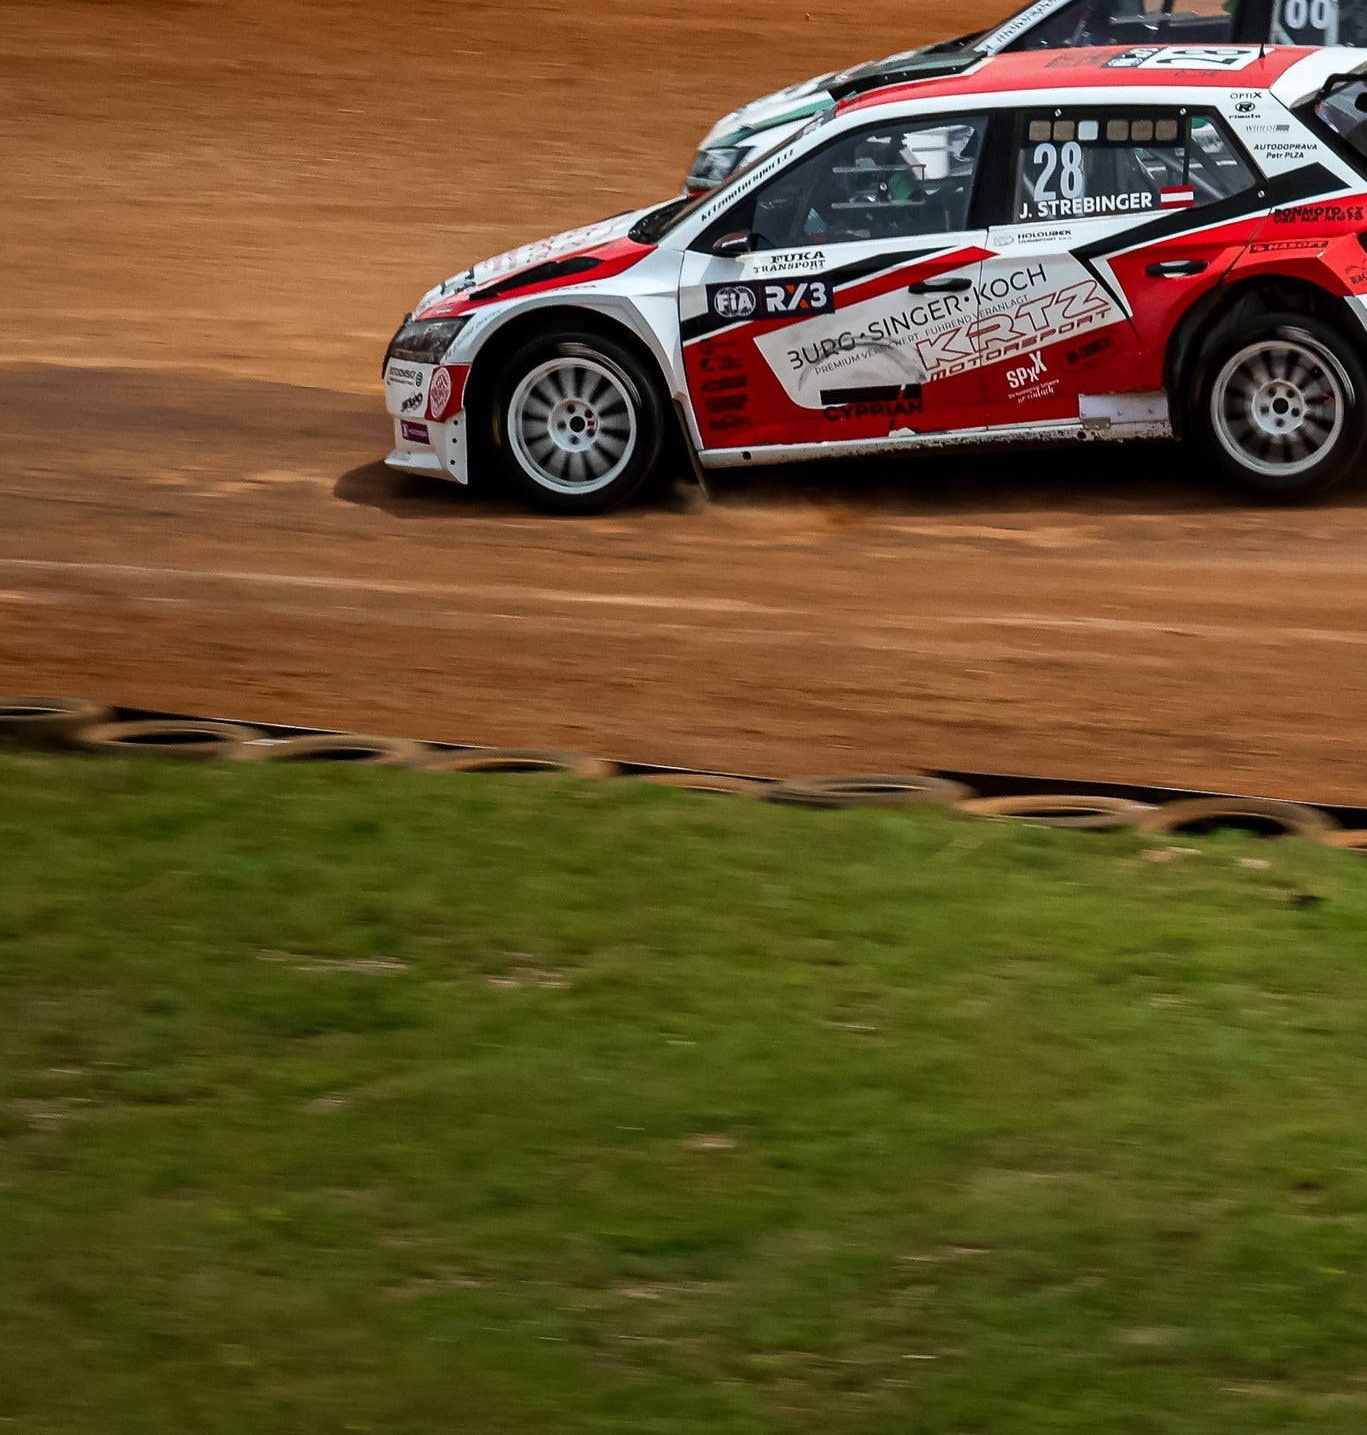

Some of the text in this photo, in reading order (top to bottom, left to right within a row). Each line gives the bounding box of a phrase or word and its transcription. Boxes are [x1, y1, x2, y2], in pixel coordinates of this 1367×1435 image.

[1253, 143, 1317, 151] AUTODOPRAVA
[1266, 151, 1304, 159] Petr PLZA
[1032, 140, 1084, 201] 28
[1019, 192, 1152, 220] J. STREBINGER
[753, 259, 826, 274] TRANSPORT
[770, 250, 826, 264] FUKA
[715, 281, 827, 313] FIA RX3
[867, 294, 963, 341] SINGER
[973, 263, 1048, 306] KOCH
[914, 279, 1110, 371] KRTZ
[930, 307, 1112, 382] MOTORSPORT
[823, 400, 925, 422] CYPRIAN
